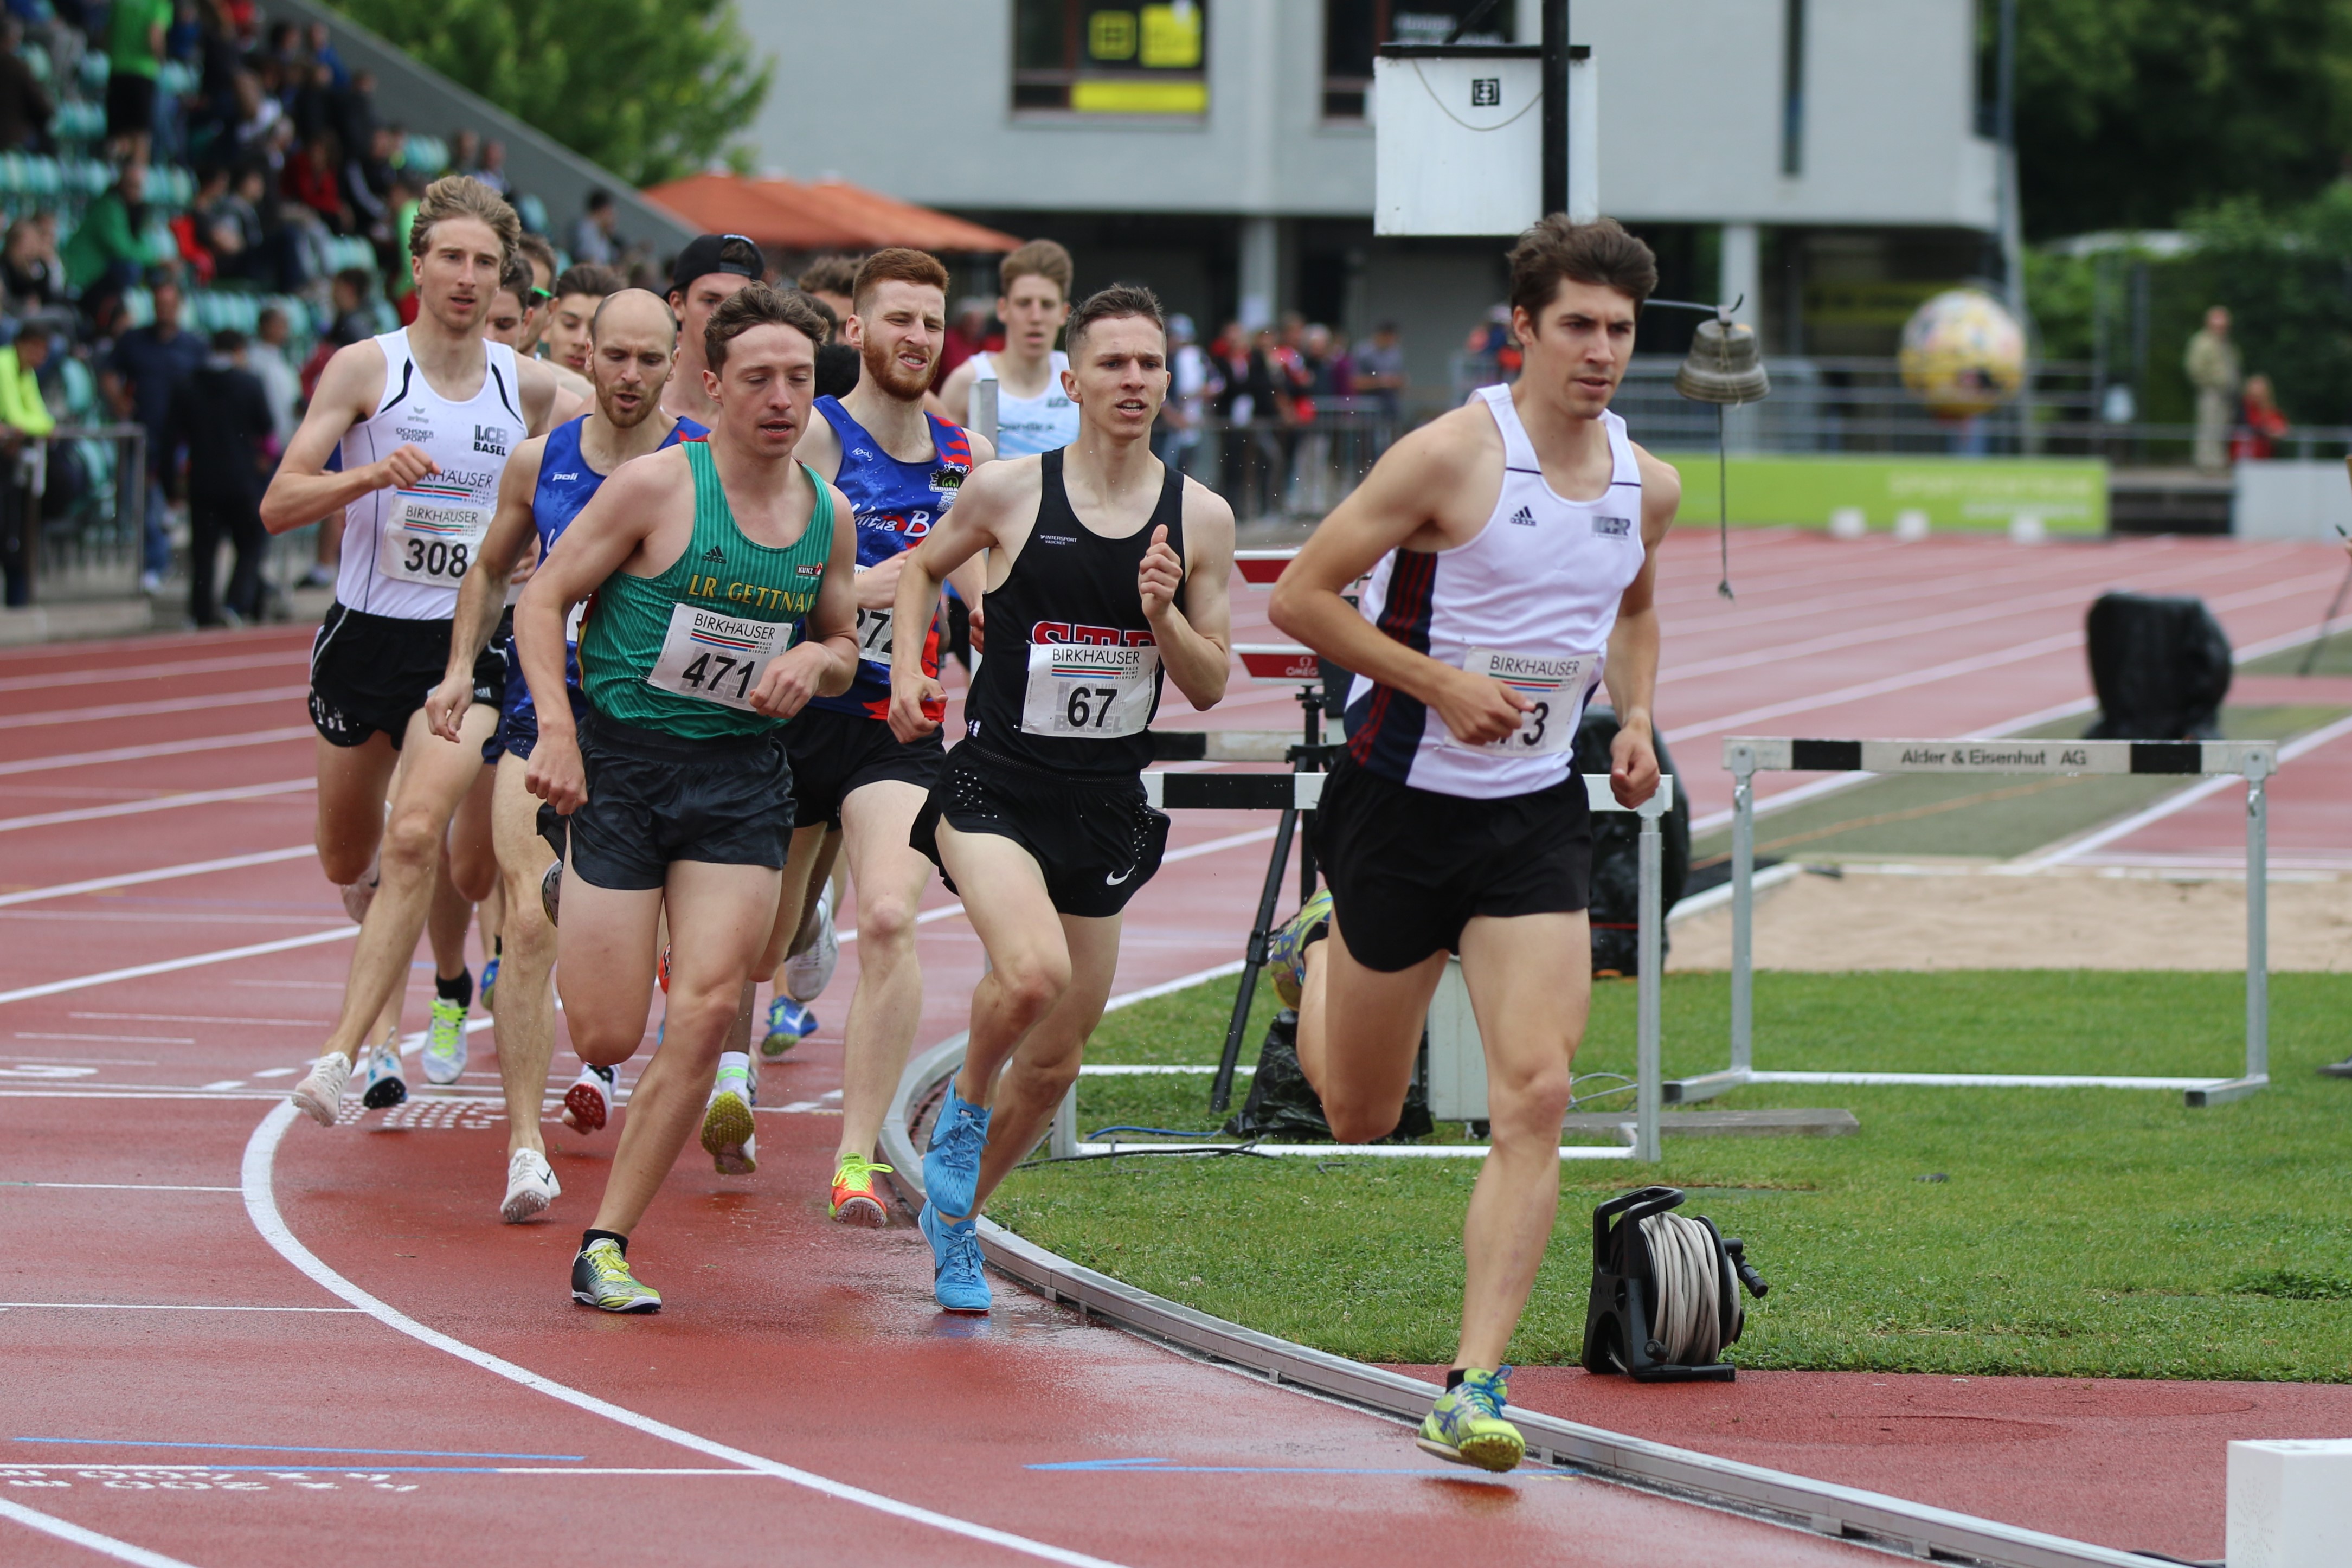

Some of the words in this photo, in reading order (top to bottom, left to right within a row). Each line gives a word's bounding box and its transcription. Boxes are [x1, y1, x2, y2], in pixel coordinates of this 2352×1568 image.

[396, 427, 434, 438] OCHSNER
[401, 434, 427, 443] SPORT
[474, 441, 506, 456] BASEL
[552, 473, 578, 481] poli
[407, 505, 478, 523] BIRKHÄUSER
[1510, 517, 1537, 526] adidas
[1045, 535, 1077, 543] INTERSPORT
[404, 538, 468, 578] 308
[702, 555, 727, 564] adidas
[688, 574, 718, 598] LR
[694, 613, 775, 640] BIRKHÄUSER
[1052, 649, 1140, 664] BIRKHÄUSER
[1286, 667, 1318, 677] OMEG
[1490, 655, 1580, 676] BIRKHÄUSER
[682, 653, 755, 698] 471
[1068, 687, 1117, 728] 67
[1500, 702, 1549, 746] 3
[1901, 749, 1946, 764] Alder
[1953, 750, 1964, 764] &
[1969, 750, 2046, 765] Eisenhut
[2061, 750, 2086, 765] AG
